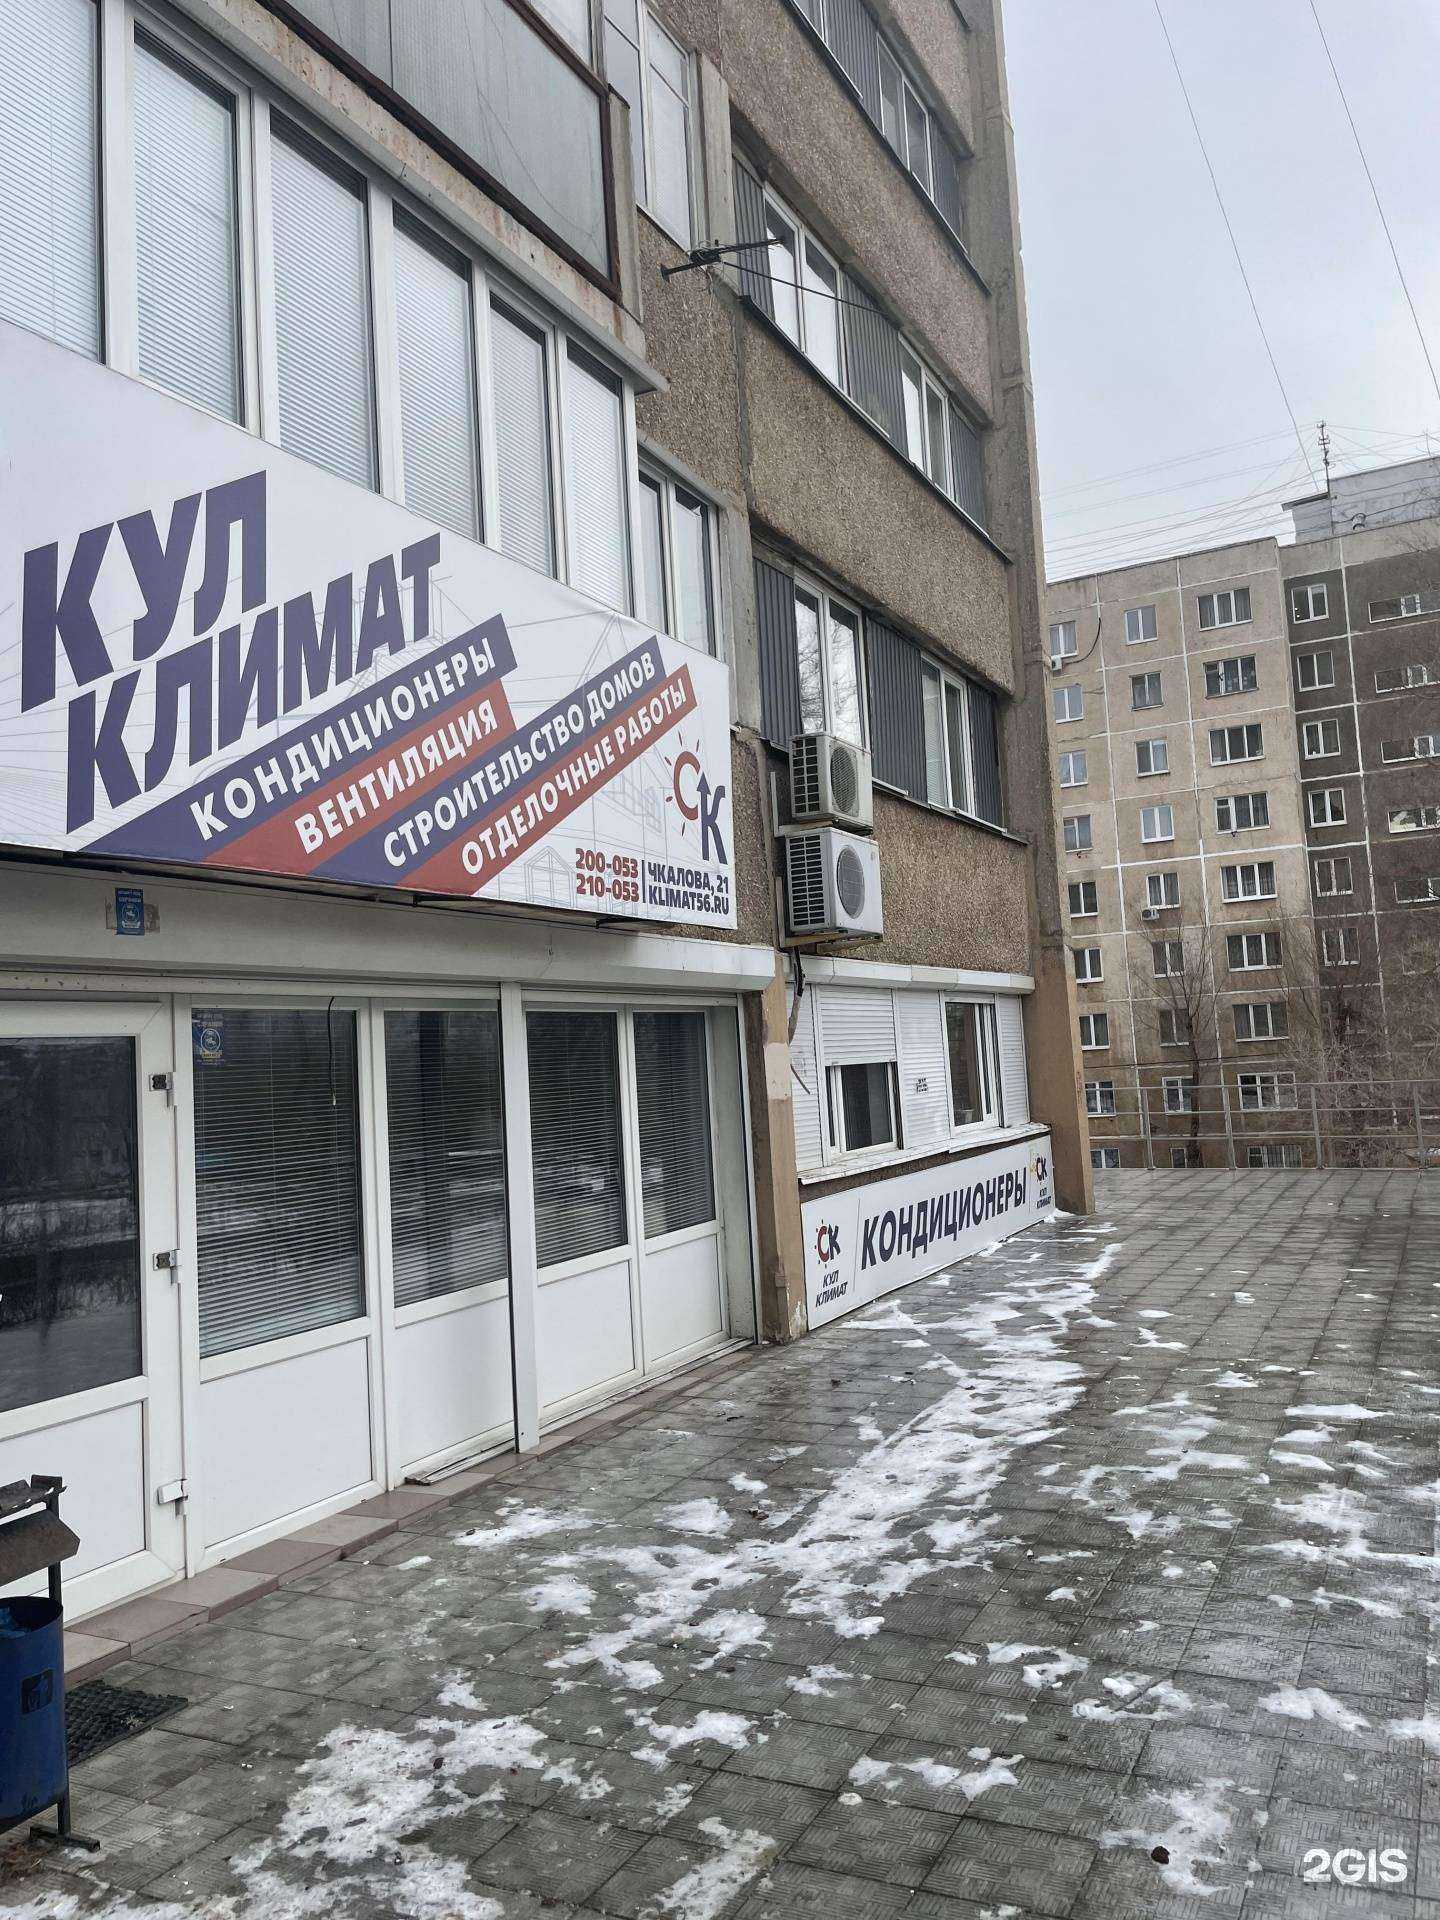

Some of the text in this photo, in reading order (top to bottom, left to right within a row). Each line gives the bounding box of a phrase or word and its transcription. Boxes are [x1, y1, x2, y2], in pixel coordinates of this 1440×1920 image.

[22, 470, 266, 713] КУЛ
[67, 533, 440, 834] КЛИМАТ
[190, 637, 496, 841] КОНДИЦИОНЕРЫ
[294, 700, 497, 854] ВЕНТИЛЯЦИЯ
[384, 652, 656, 867] СТРОИТЕЛЬСТВО ДОМОВ
[461, 680, 687, 875] ОТДЕЛОЧНЫЕ РАБОТЫ
[576, 848, 638, 878] 200-053
[576, 873, 639, 902] 210-053
[648, 862, 729, 895] ЧКАЛОВА, 21
[649, 885, 729, 915] KLIMAT56.RU
[861, 1167, 1027, 1270] КОНДИЦИОНЕРЫ
[816, 1281, 848, 1307] КЛИМАТ
